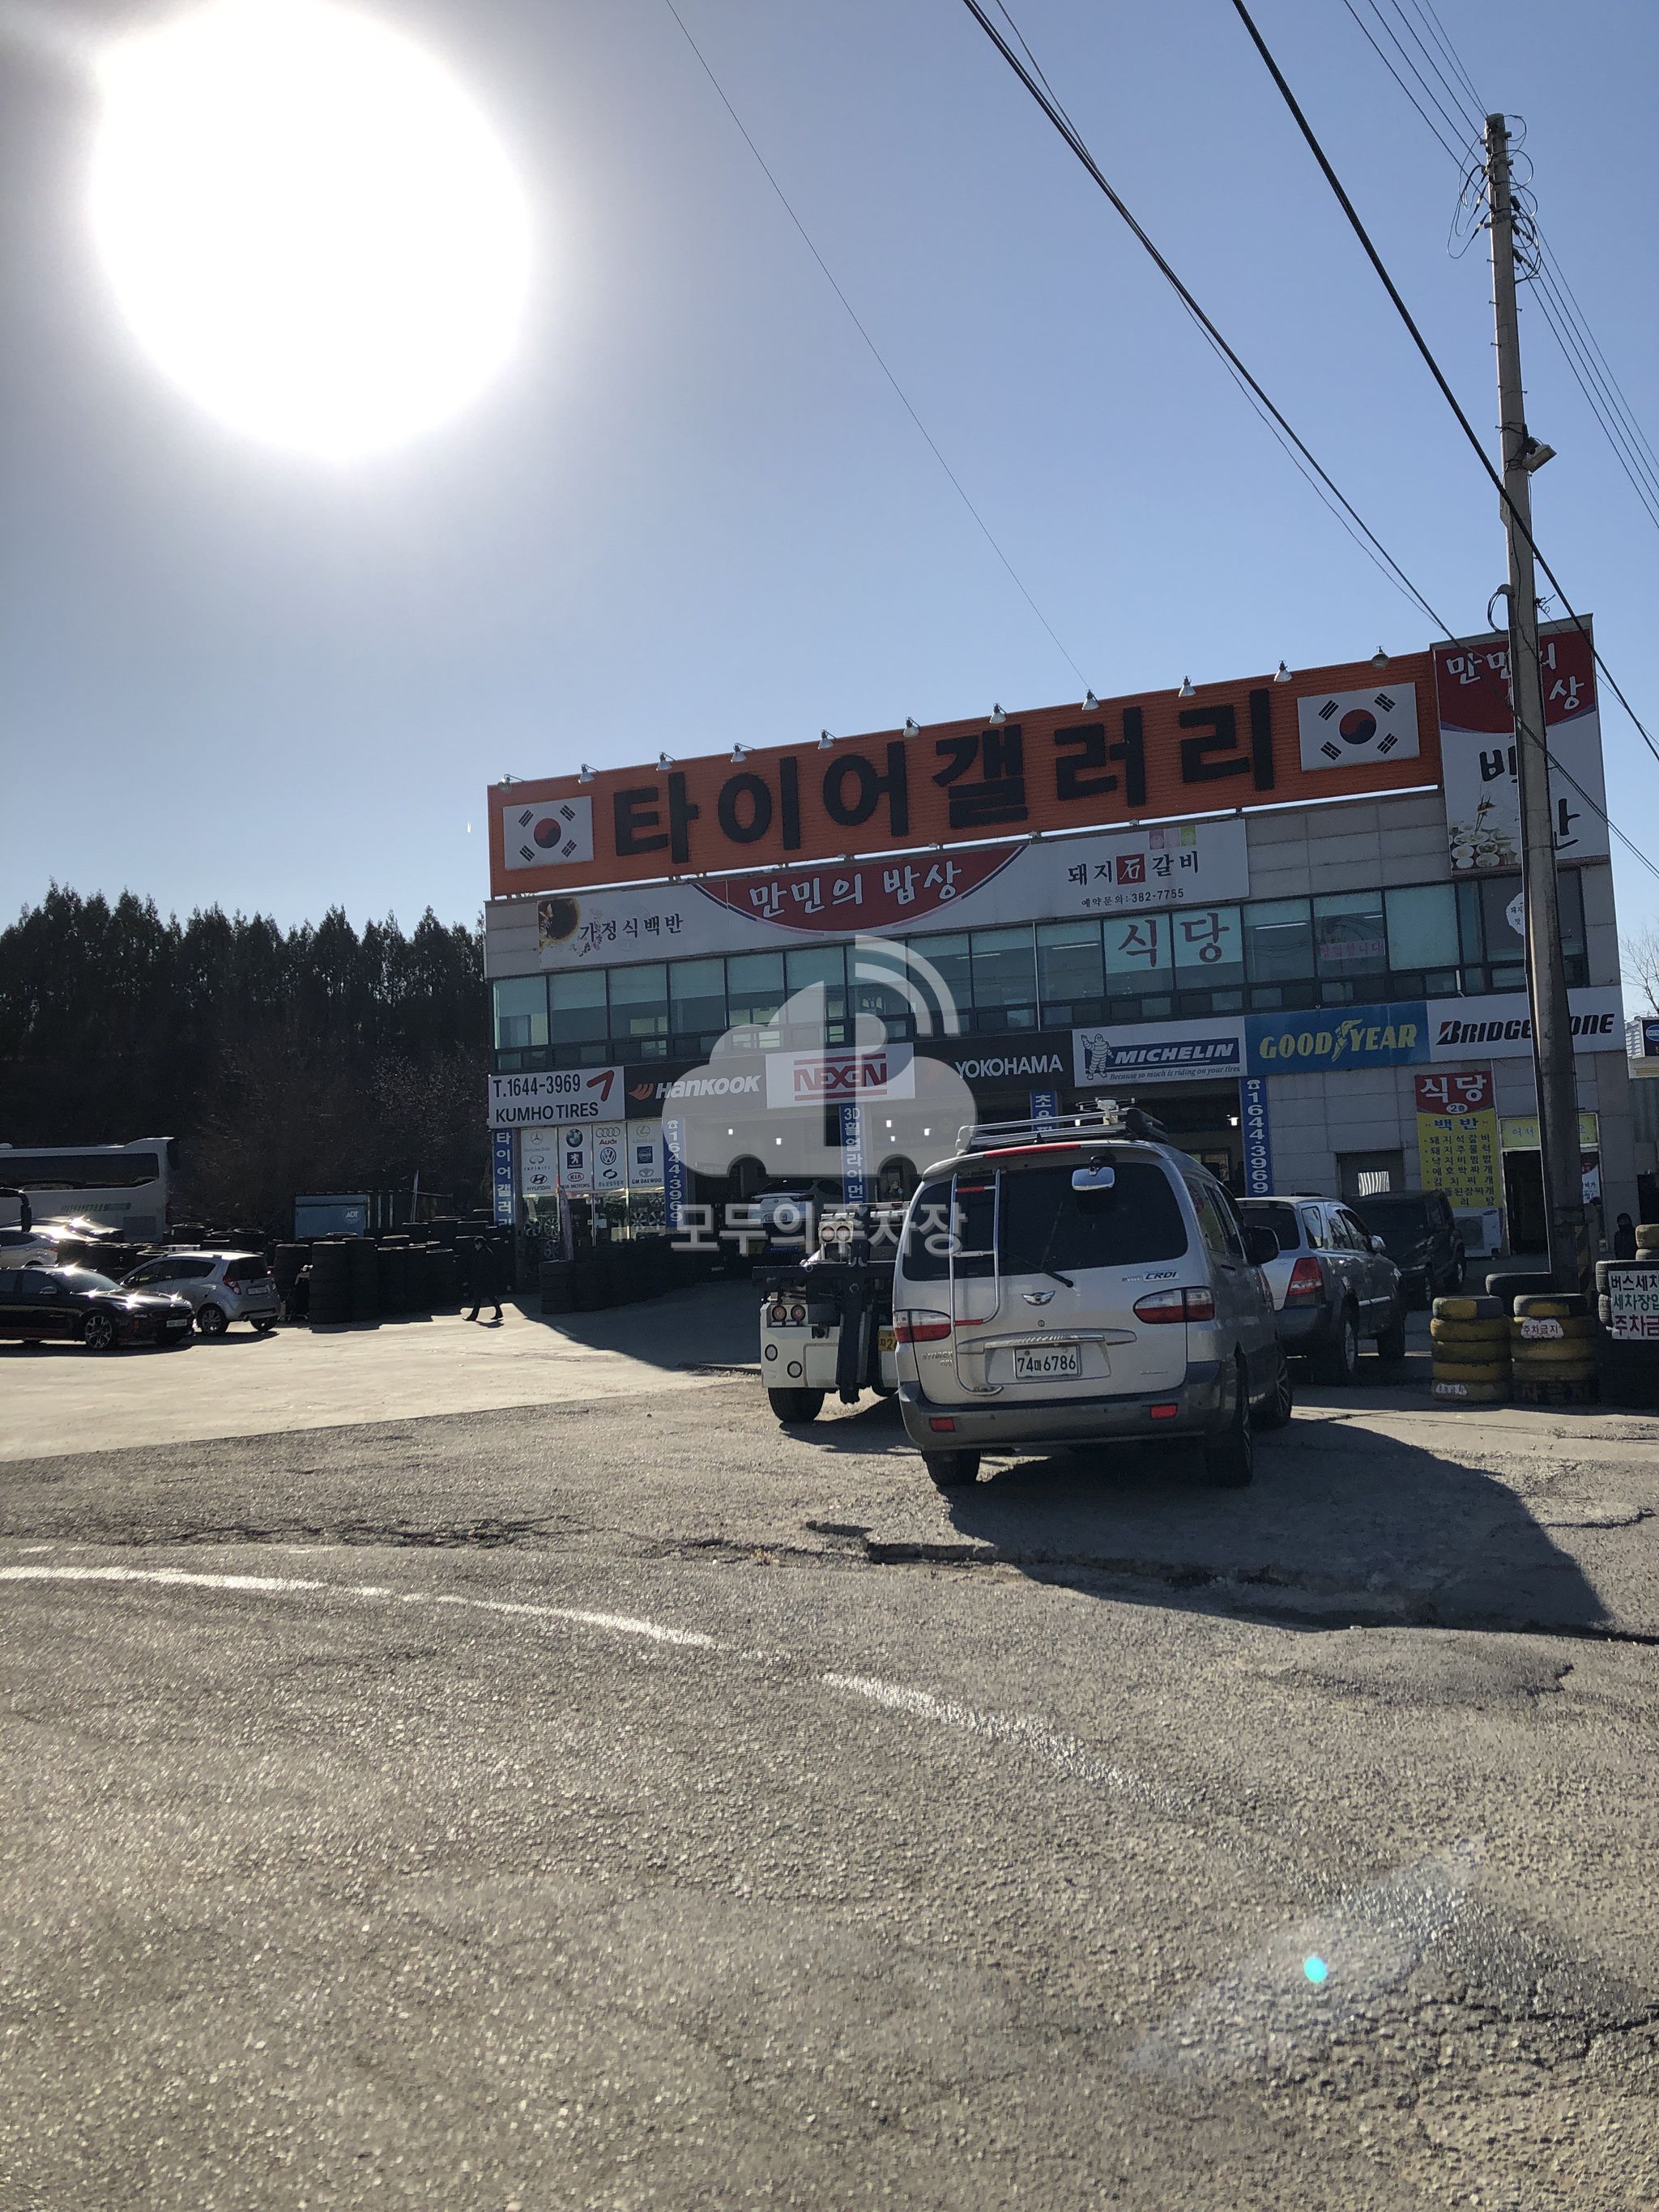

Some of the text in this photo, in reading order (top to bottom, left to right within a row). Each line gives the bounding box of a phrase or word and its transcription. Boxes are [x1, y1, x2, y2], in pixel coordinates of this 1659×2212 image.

[613, 688, 1275, 864] 타이어갤러리
[749, 859, 962, 918] 만민의 밥상
[1132, 888, 1184, 903] 382-7755
[579, 913, 684, 944] 가정식백반
[1118, 912, 1230, 968] 식당
[1435, 1012, 1616, 1046] BRIDGEONE
[954, 1053, 1064, 1079] YOKOHAMA
[1115, 1043, 1234, 1064] MICHELIN
[794, 1061, 887, 1092] NEXEN
[1175, 1068, 1196, 1078] riding
[1207, 1067, 1224, 1076] your
[1225, 1065, 1240, 1073] tires
[493, 1073, 581, 1098] T.1644-3969
[1420, 1075, 1487, 1103] 식당
[496, 1102, 599, 1123] KUMHO TIRES
[844, 1107, 860, 1120] 3D
[1434, 1117, 1479, 1132] 백반
[1524, 1323, 1560, 1336] 주차금지
